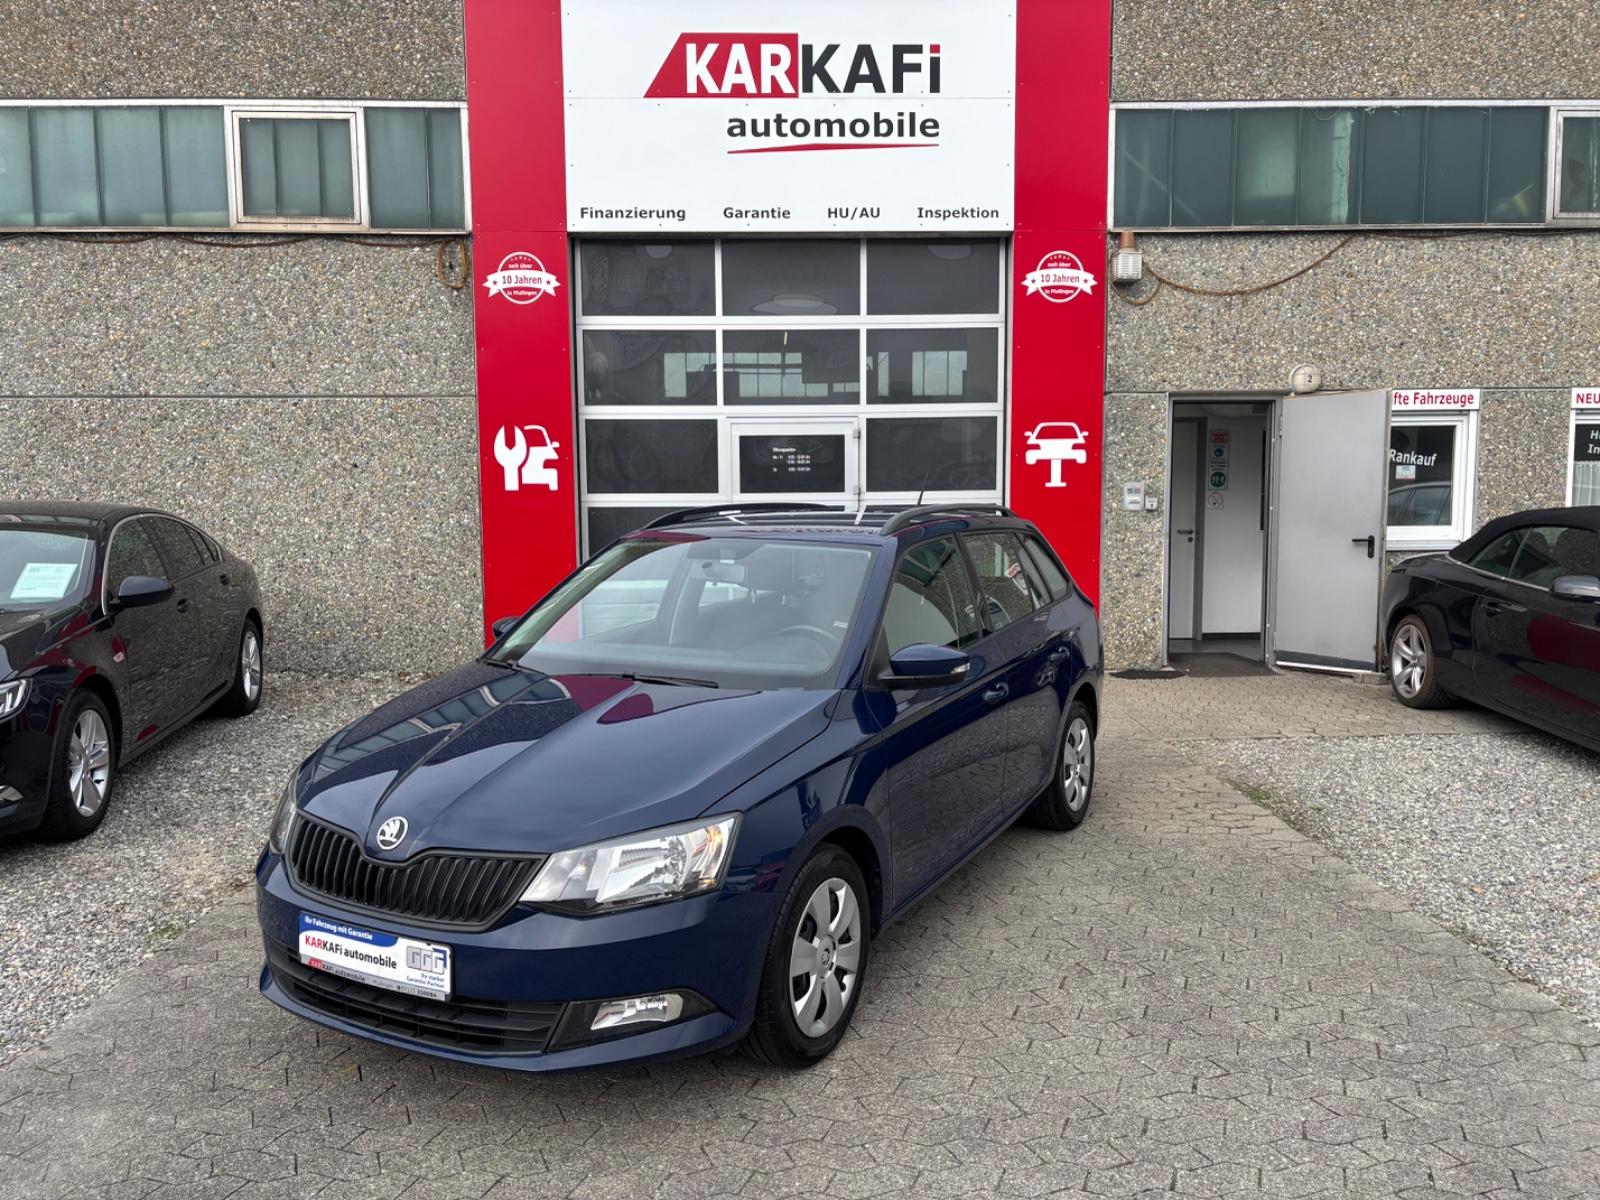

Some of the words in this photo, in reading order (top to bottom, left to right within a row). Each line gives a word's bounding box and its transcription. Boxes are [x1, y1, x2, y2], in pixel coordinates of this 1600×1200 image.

[685, 43, 941, 94] KARKAFi
[726, 112, 940, 138] automobile
[579, 207, 686, 222] Finanzierung
[722, 207, 791, 219] Garantie
[827, 207, 881, 219] HU/AU
[917, 206, 1000, 221] Inspektion
[502, 275, 512, 284] 10
[514, 275, 542, 284] Jahren
[1041, 274, 1051, 283] 10
[1053, 273, 1080, 283] Jahren
[1307, 374, 1313, 383] 2
[1394, 392, 1409, 405] fte
[1414, 392, 1474, 408] Fahrzeuge
[313, 918, 337, 933] Fahrzeug
[337, 926, 348, 934] mit
[348, 928, 373, 940] Garantie
[305, 934, 343, 955] KARKAFi
[344, 947, 398, 970] automobile
